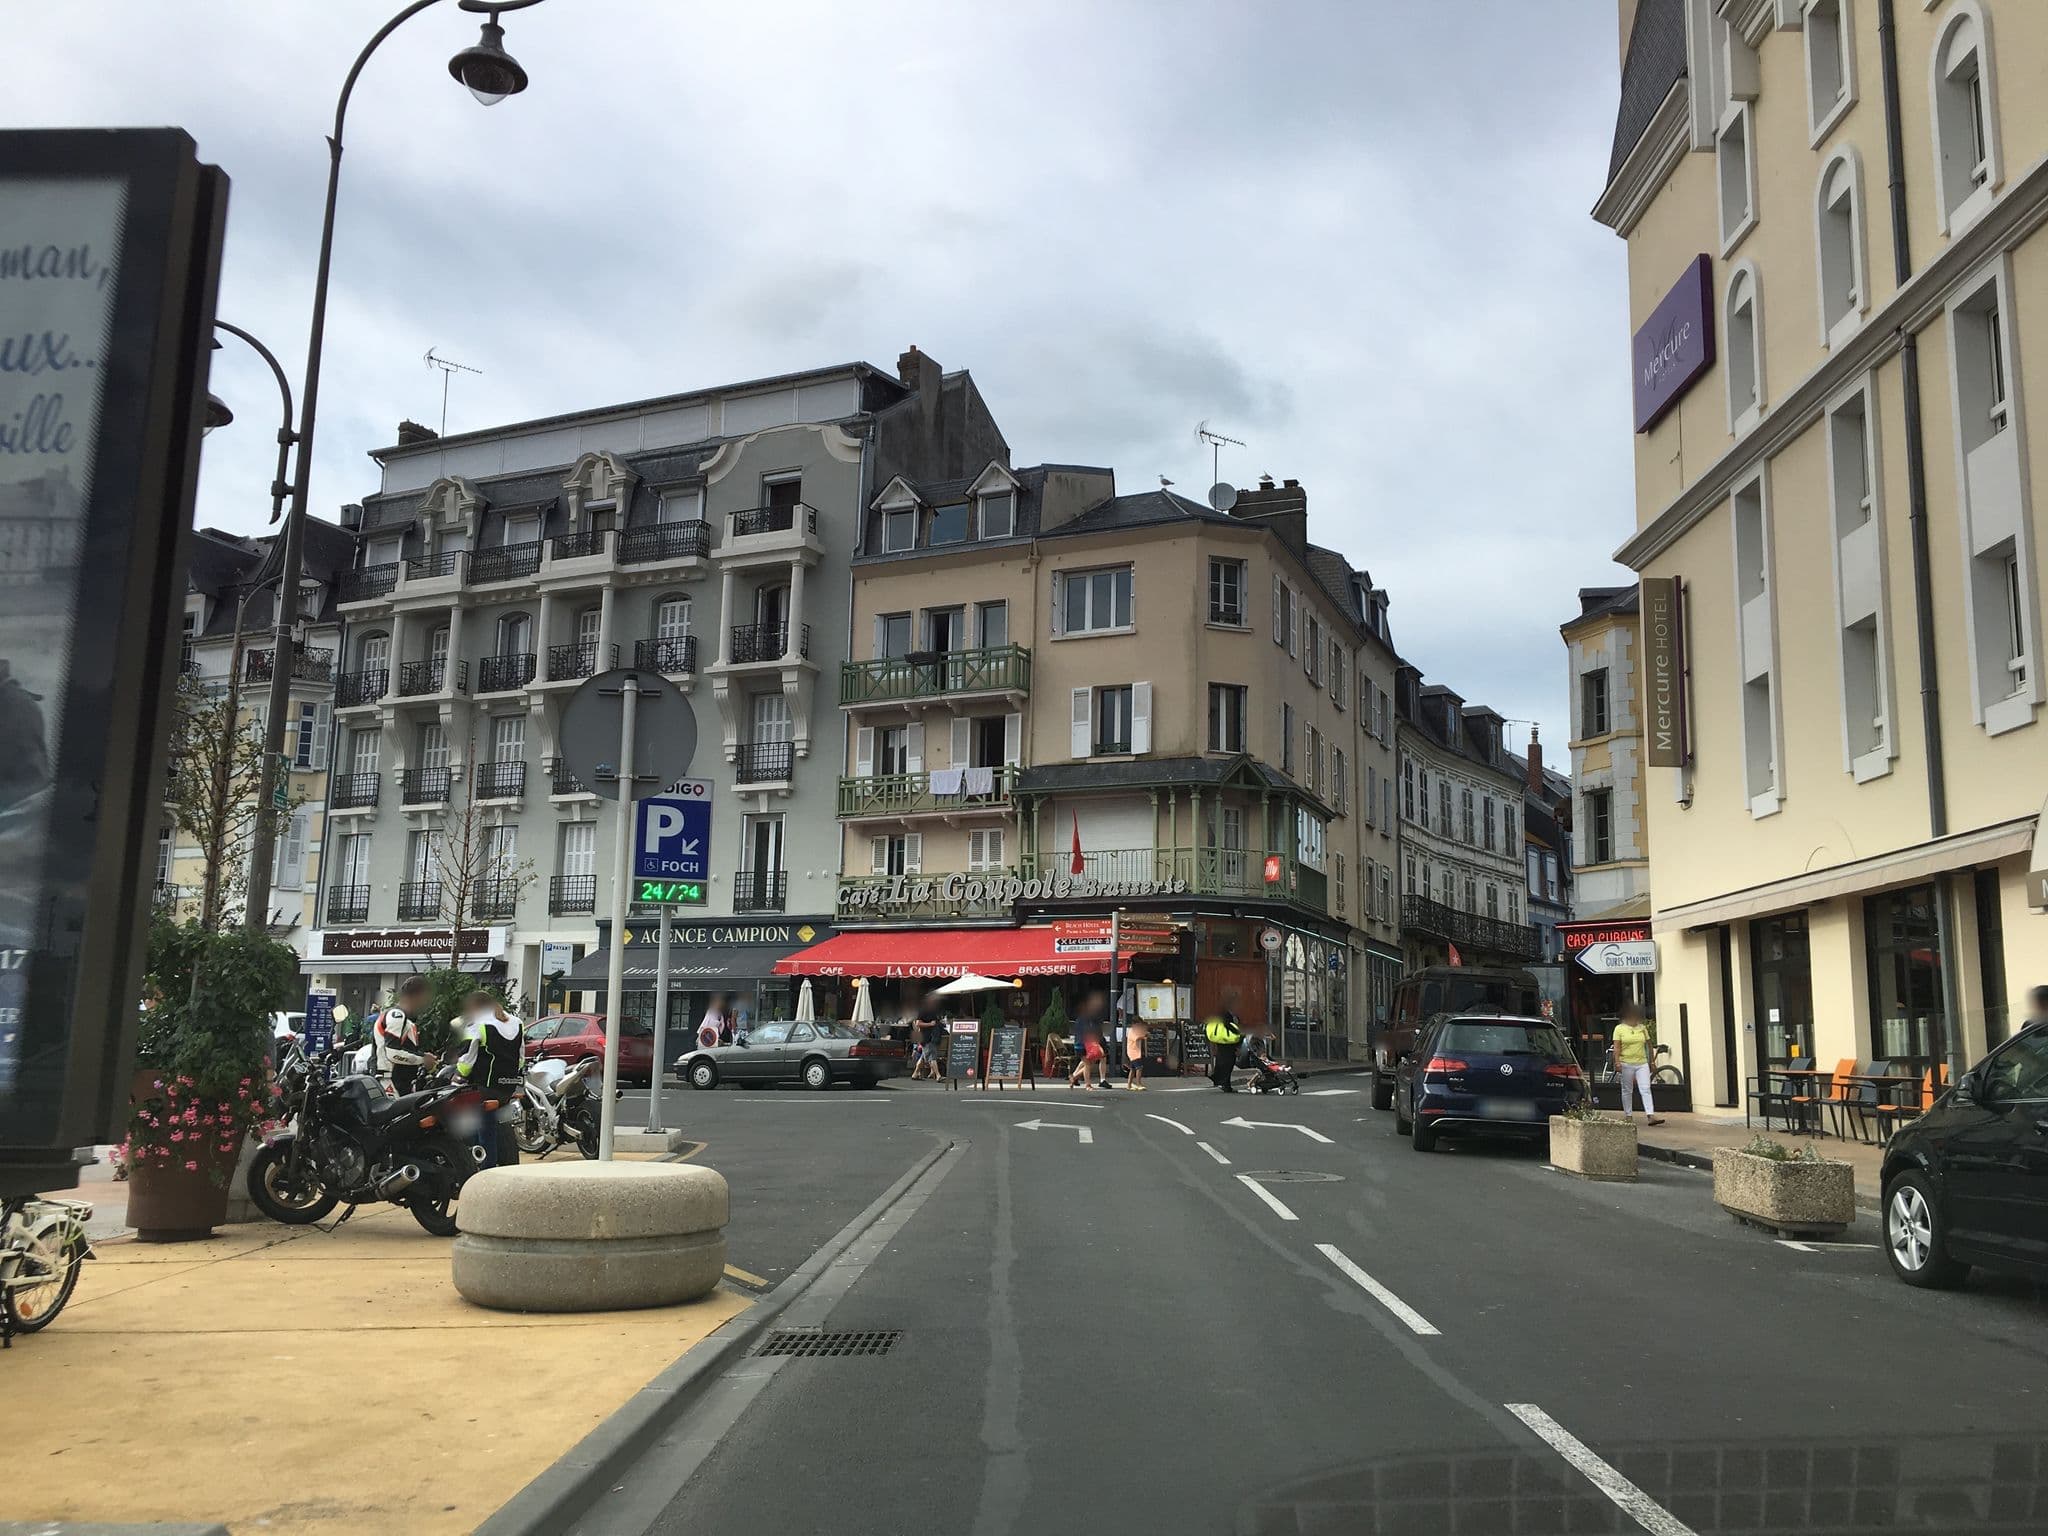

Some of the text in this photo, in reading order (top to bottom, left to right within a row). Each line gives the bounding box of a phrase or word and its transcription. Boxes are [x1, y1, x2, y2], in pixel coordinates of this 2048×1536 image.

[1643, 321, 1690, 386] Mercure
[1654, 592, 1671, 750] Mercure HOTEL
[645, 804, 685, 853] P
[661, 861, 699, 873] FOCH
[836, 870, 1185, 907] Café La Coupole Brasserie
[712, 926, 790, 943] CAMPION
[351, 939, 393, 949] COMPTOIR
[394, 938, 409, 948] DES
[1626, 956, 1653, 966] MARINES
[887, 966, 902, 976] LA
[909, 966, 969, 976] COUPOLE
[1018, 965, 1077, 974] BRASSERIE
